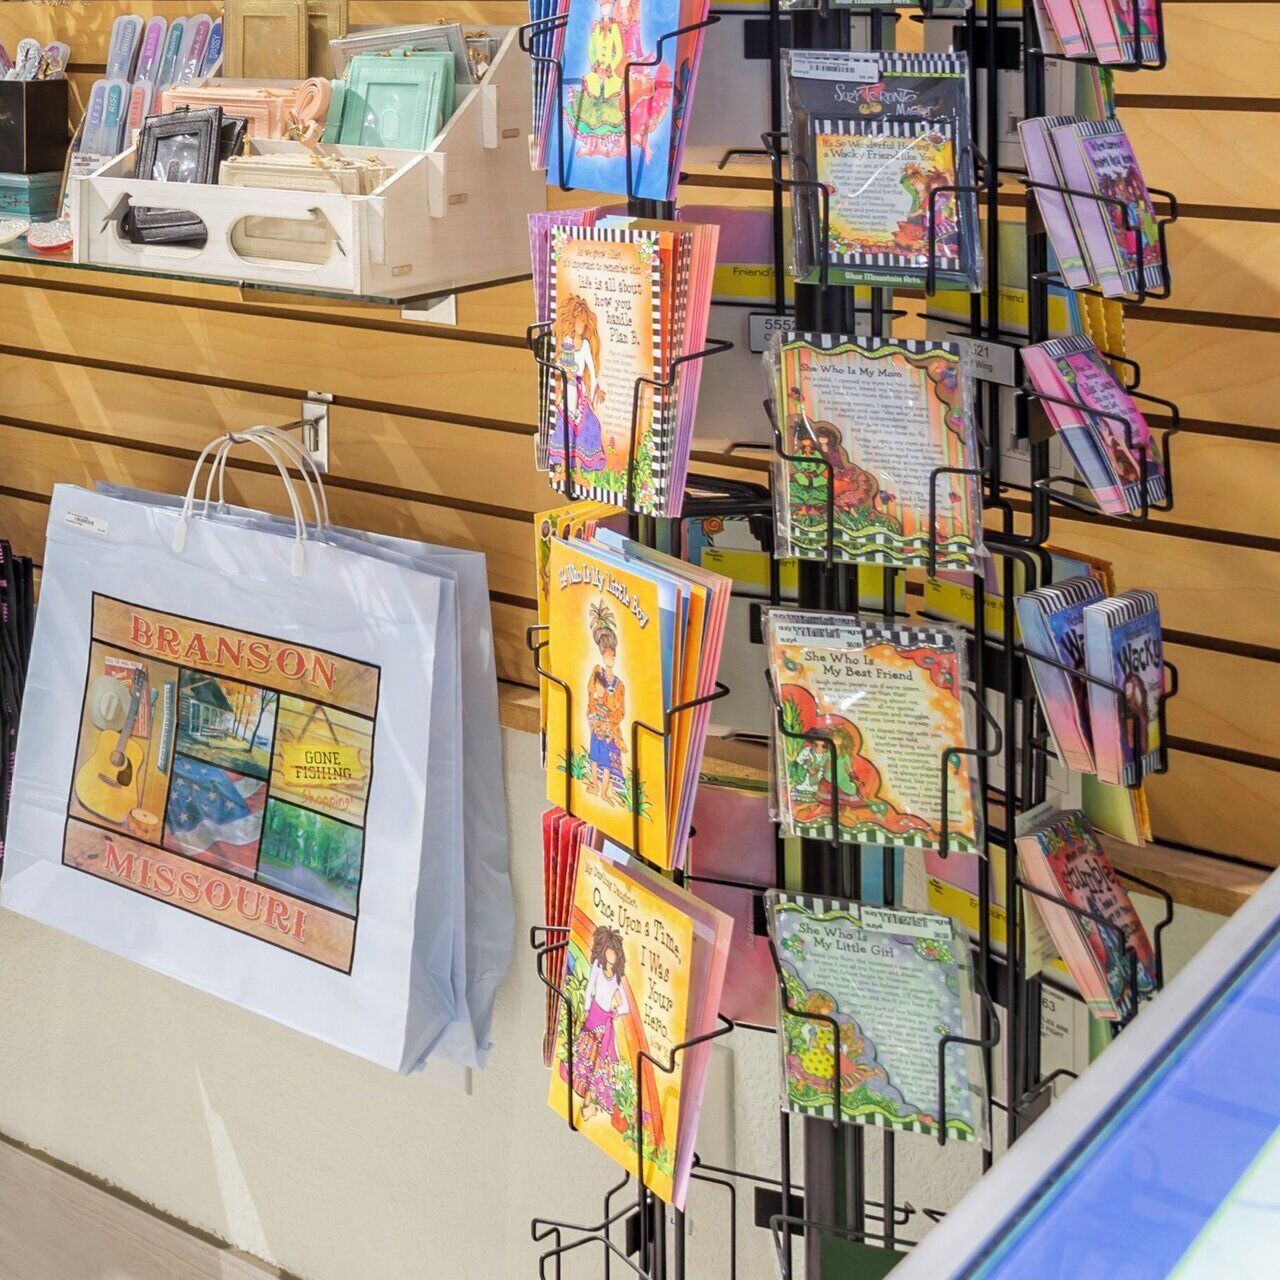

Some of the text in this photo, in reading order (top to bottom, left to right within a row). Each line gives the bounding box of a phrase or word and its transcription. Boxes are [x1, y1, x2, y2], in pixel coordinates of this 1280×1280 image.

[108, 91, 119, 113] RISE
[830, 150, 865, 162] Wacky
[594, 292, 632, 314] how you
[606, 310, 633, 327] handle
[610, 328, 628, 345] Plan
[800, 363, 902, 378] She Who Is My Mom
[606, 574, 650, 628] Little Boy
[130, 613, 338, 694] BRANSON
[1116, 643, 1163, 678] Wacky
[845, 666, 914, 681] Best Friend
[304, 750, 341, 765] GONE
[295, 765, 352, 781] FISHING
[104, 841, 309, 944] MISSOURI
[592, 887, 615, 922] Once
[617, 904, 642, 935] Upon
[836, 939, 895, 958] Little Girl
